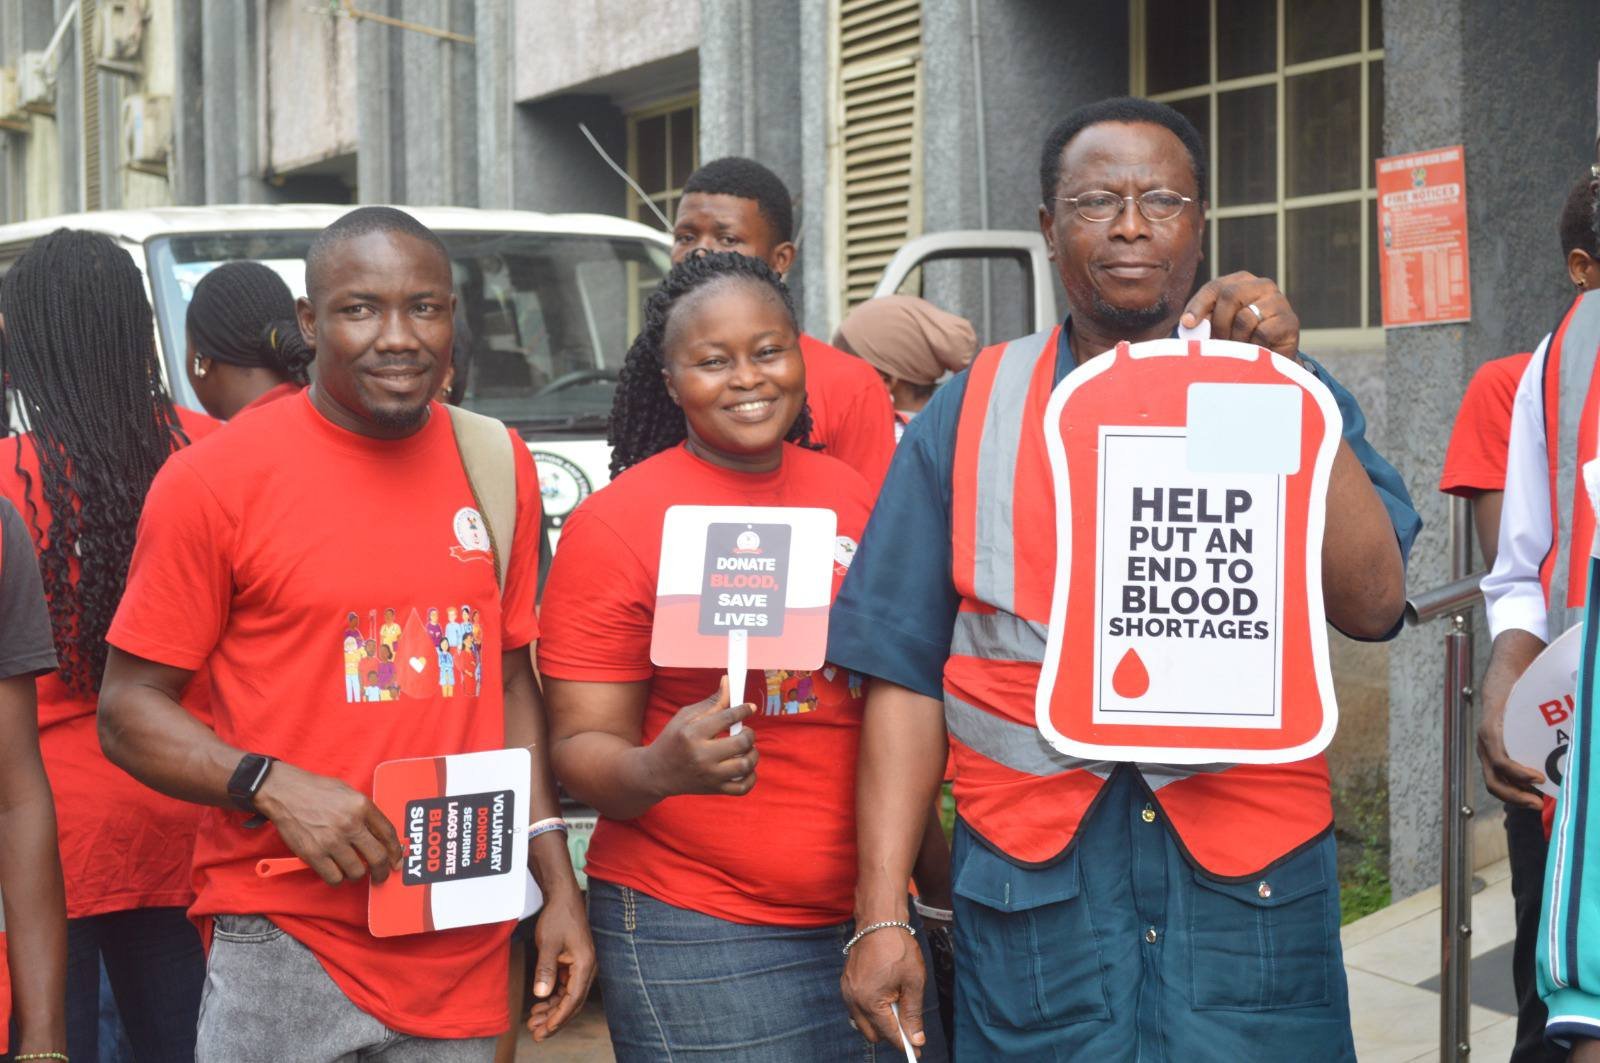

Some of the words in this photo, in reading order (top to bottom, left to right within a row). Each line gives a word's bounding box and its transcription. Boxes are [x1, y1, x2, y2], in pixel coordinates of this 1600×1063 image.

[1132, 487, 1253, 524] HELP
[1129, 526, 1197, 552] PUT
[1205, 528, 1253, 554] AN
[716, 557, 776, 572] DONATE
[1127, 556, 1197, 583] END
[1205, 558, 1254, 584] TO
[710, 573, 779, 591] BLOOD,
[717, 593, 768, 608] SAVE
[1122, 585, 1259, 616] BLOOD
[713, 612, 769, 627] LIVES
[1108, 617, 1269, 640] SHORTAGES
[446, 802, 459, 840] LAGOS
[461, 806, 473, 868] SECURING
[473, 807, 489, 864] DONORS,
[490, 794, 505, 872] VOLUNTARY
[408, 806, 425, 878] SUPPLY
[427, 808, 443, 872] BLOOD
[445, 840, 458, 876] STATE
